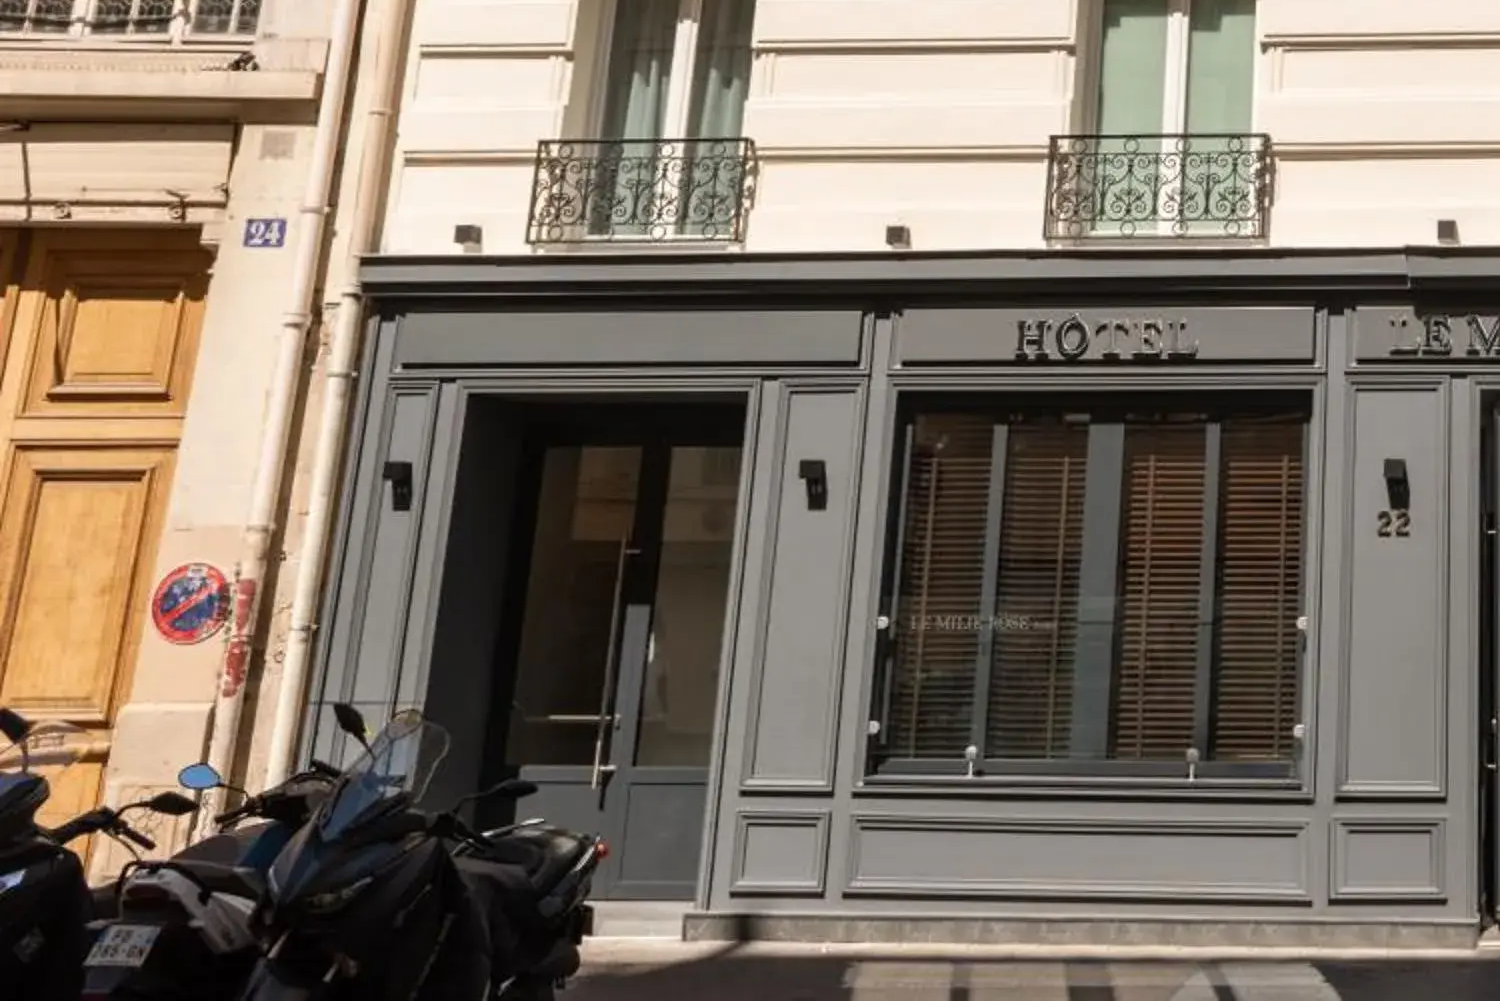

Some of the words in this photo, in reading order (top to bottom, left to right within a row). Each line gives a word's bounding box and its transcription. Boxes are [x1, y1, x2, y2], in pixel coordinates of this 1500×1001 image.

[249, 221, 281, 245] 24
[1016, 312, 1198, 360] HÔTEL
[1390, 315, 1452, 356] LE
[1377, 510, 1411, 538] 22
